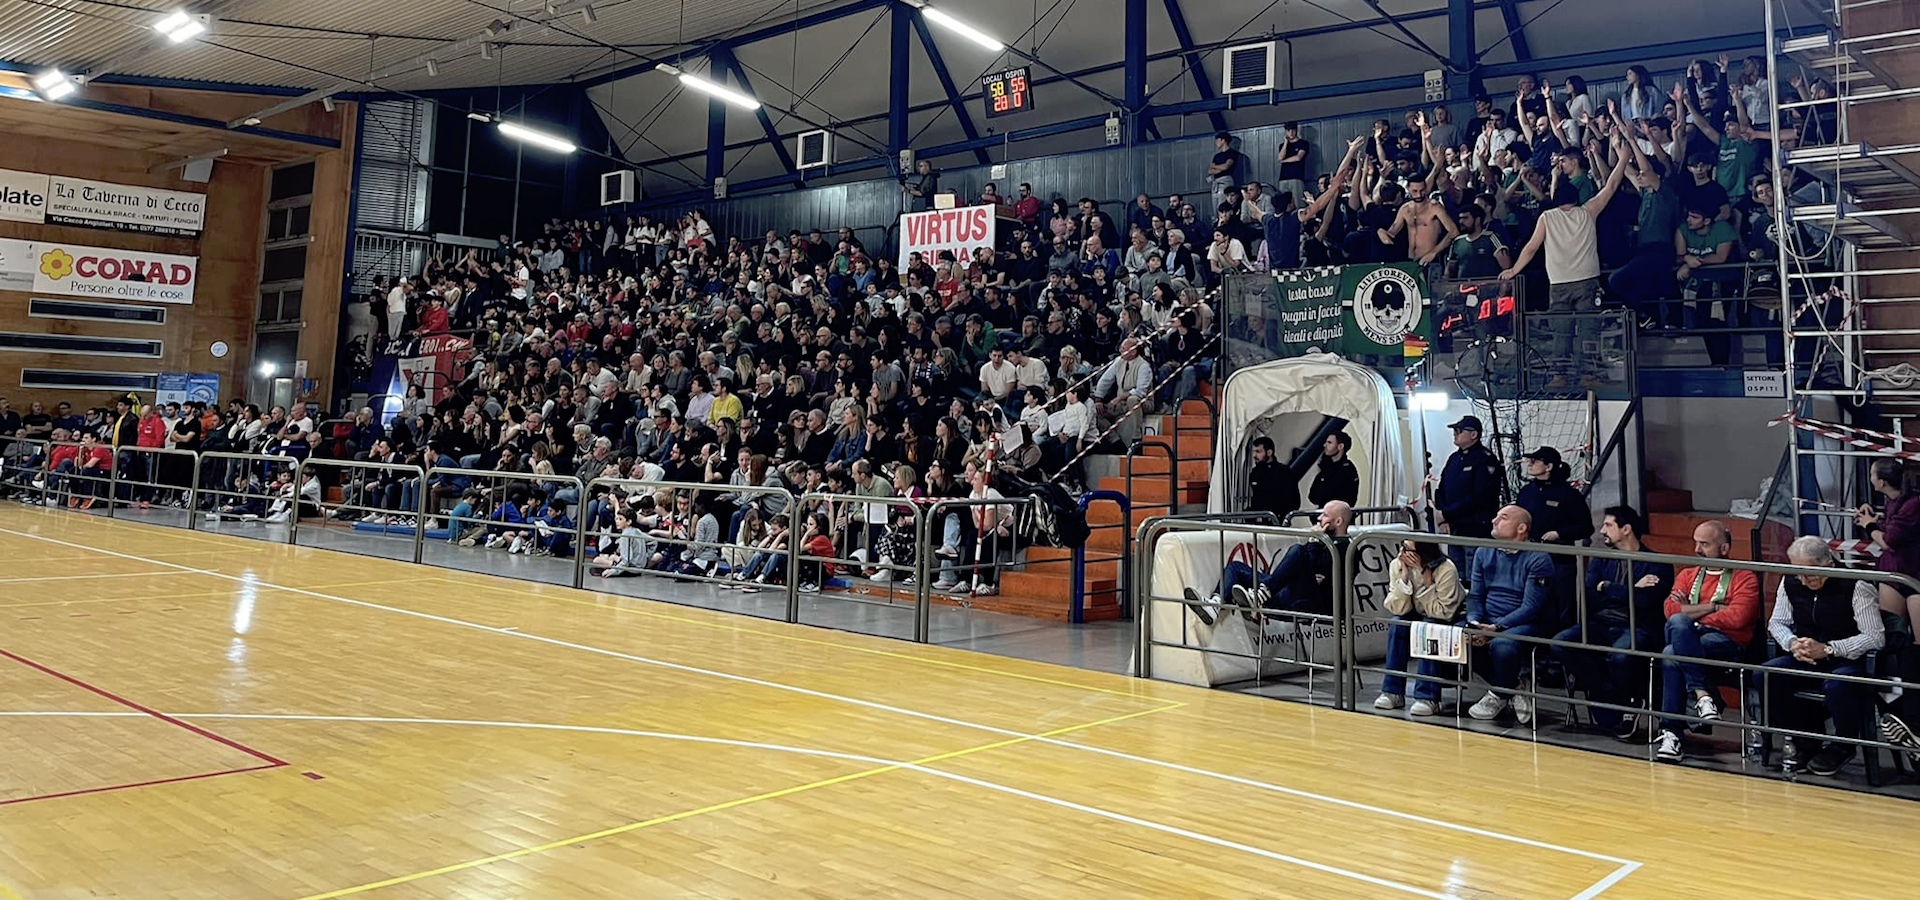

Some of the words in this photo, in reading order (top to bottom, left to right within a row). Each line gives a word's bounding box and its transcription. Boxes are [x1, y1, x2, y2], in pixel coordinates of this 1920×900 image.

[983, 74, 1002, 85] LOCALI
[1005, 69, 1025, 79] OSPITI
[991, 81, 1004, 97] 58
[994, 95, 1008, 112] 28
[1014, 92, 1022, 107] 0
[0, 186, 43, 207] late
[56, 183, 75, 199] La
[83, 187, 140, 206] Taverna
[147, 195, 158, 209] di
[164, 197, 199, 213] Cecco
[95, 208, 112, 216] ALLA
[114, 211, 136, 219] BRACE
[142, 214, 169, 222] TARTUFI
[907, 209, 987, 246] VIRTUS
[921, 246, 970, 266] SIEA
[76, 256, 191, 285] CONAD
[70, 281, 114, 293] Persone
[118, 284, 143, 296] oltre
[147, 286, 157, 297] le
[160, 290, 184, 299] cose
[1359, 273, 1377, 290] LIVE
[1308, 306, 1317, 320] in
[1307, 331, 1313, 341] e
